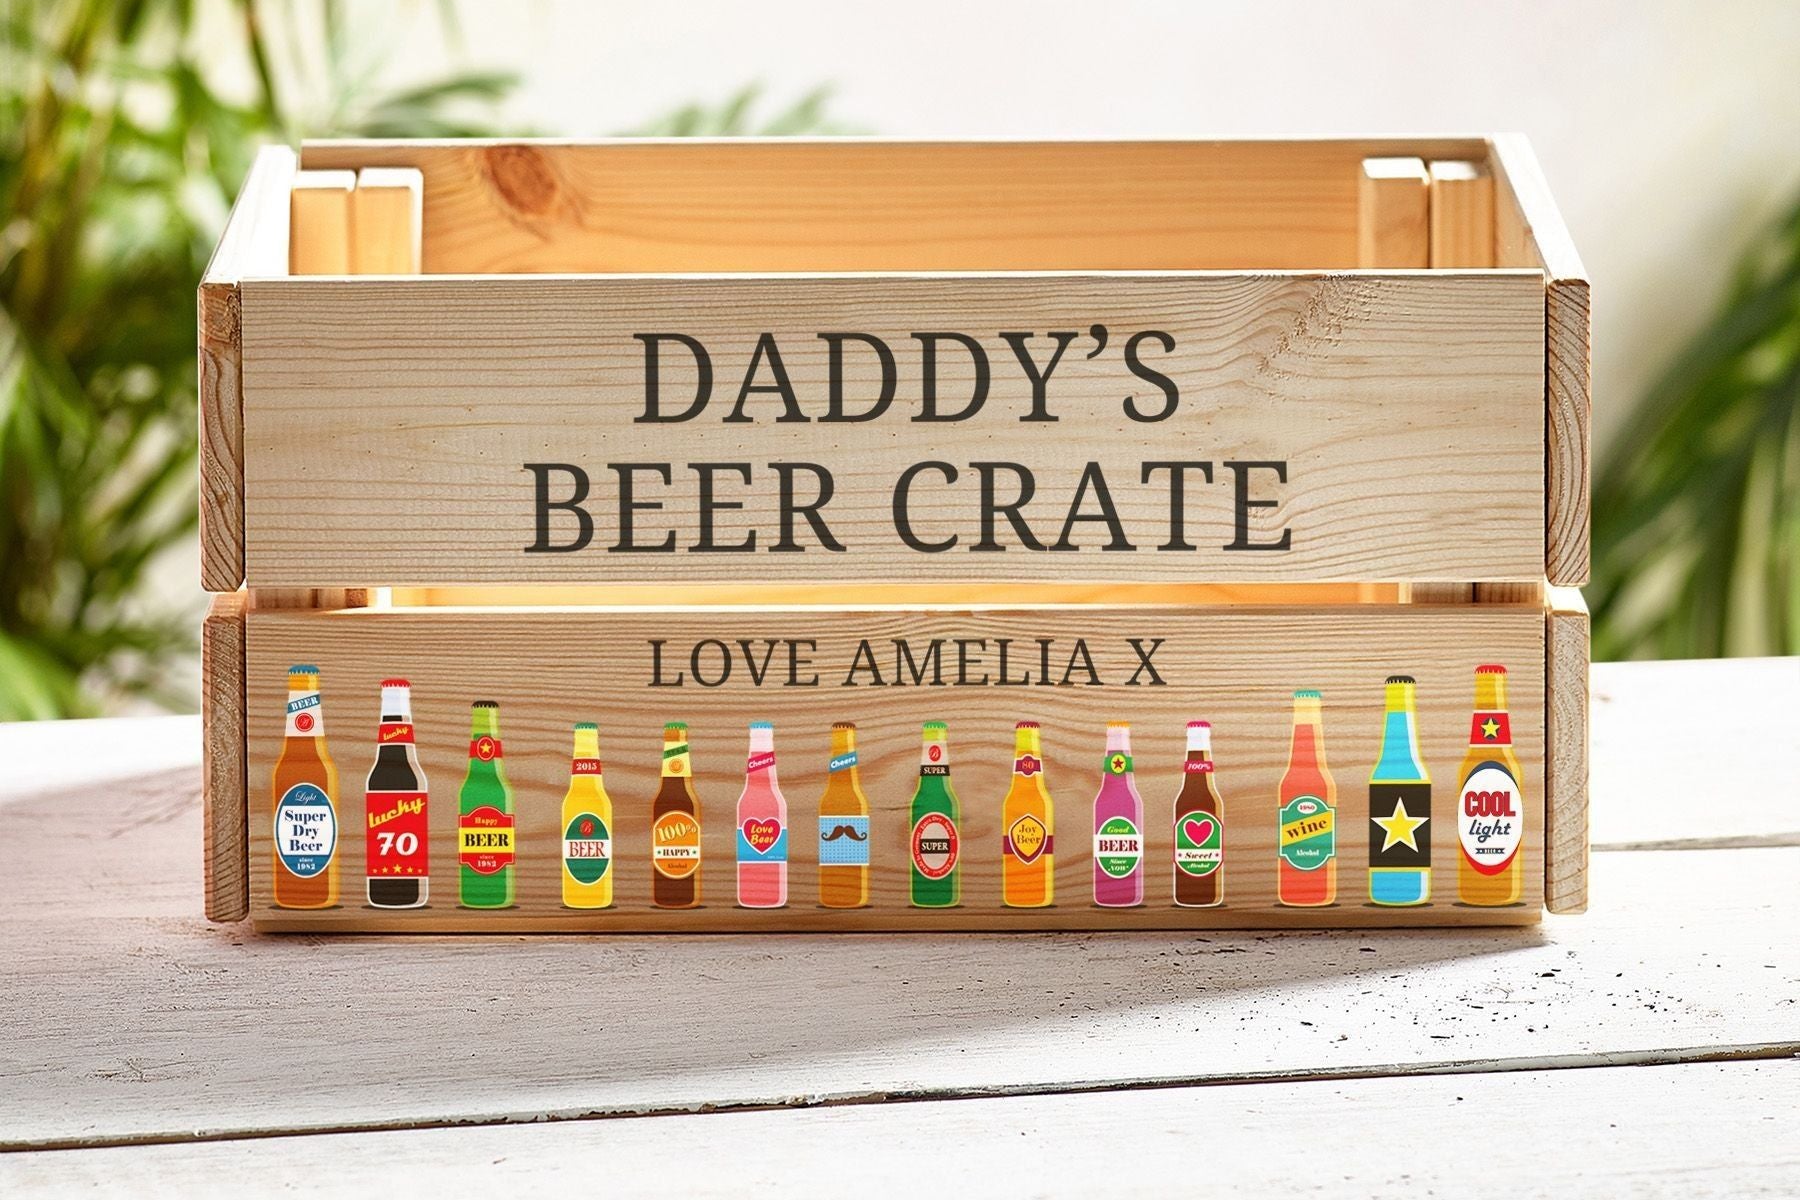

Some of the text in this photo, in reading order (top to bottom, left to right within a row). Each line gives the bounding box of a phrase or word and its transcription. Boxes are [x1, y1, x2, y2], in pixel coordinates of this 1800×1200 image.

[633, 325, 1179, 423] DADDY’S
[523, 461, 1291, 553] BEER CRATE
[648, 638, 1168, 687] LOVE AMELIA X
[291, 696, 318, 711] BEER
[383, 726, 409, 740] lucky
[576, 761, 598, 771] 2015
[748, 756, 773, 769] Cheers
[830, 755, 856, 769] Cheers
[1021, 761, 1034, 770] 80
[1187, 762, 1211, 770] 100%
[923, 766, 946, 774] SUPER
[295, 790, 317, 805] Light
[1464, 791, 1516, 817] COOL
[284, 809, 327, 825] Super
[368, 797, 426, 828] lucky
[474, 816, 498, 826] Happy
[293, 824, 319, 840] Dry
[656, 822, 697, 843] 100%
[751, 823, 774, 834] Love
[1018, 824, 1037, 836] Joy
[1107, 825, 1130, 834] Good
[1286, 820, 1327, 839] wine
[1468, 818, 1512, 844] light
[289, 839, 323, 852] Beer
[376, 832, 418, 856] 70
[464, 833, 509, 847] BEER
[751, 833, 774, 845] Beer
[1016, 834, 1041, 844] Beer
[1098, 839, 1139, 852] BEER
[569, 841, 606, 858] BEER
[663, 848, 690, 857] HAPPY
[921, 841, 949, 851] SUPER
[297, 863, 316, 871] 1982
[477, 860, 497, 868] 1982
